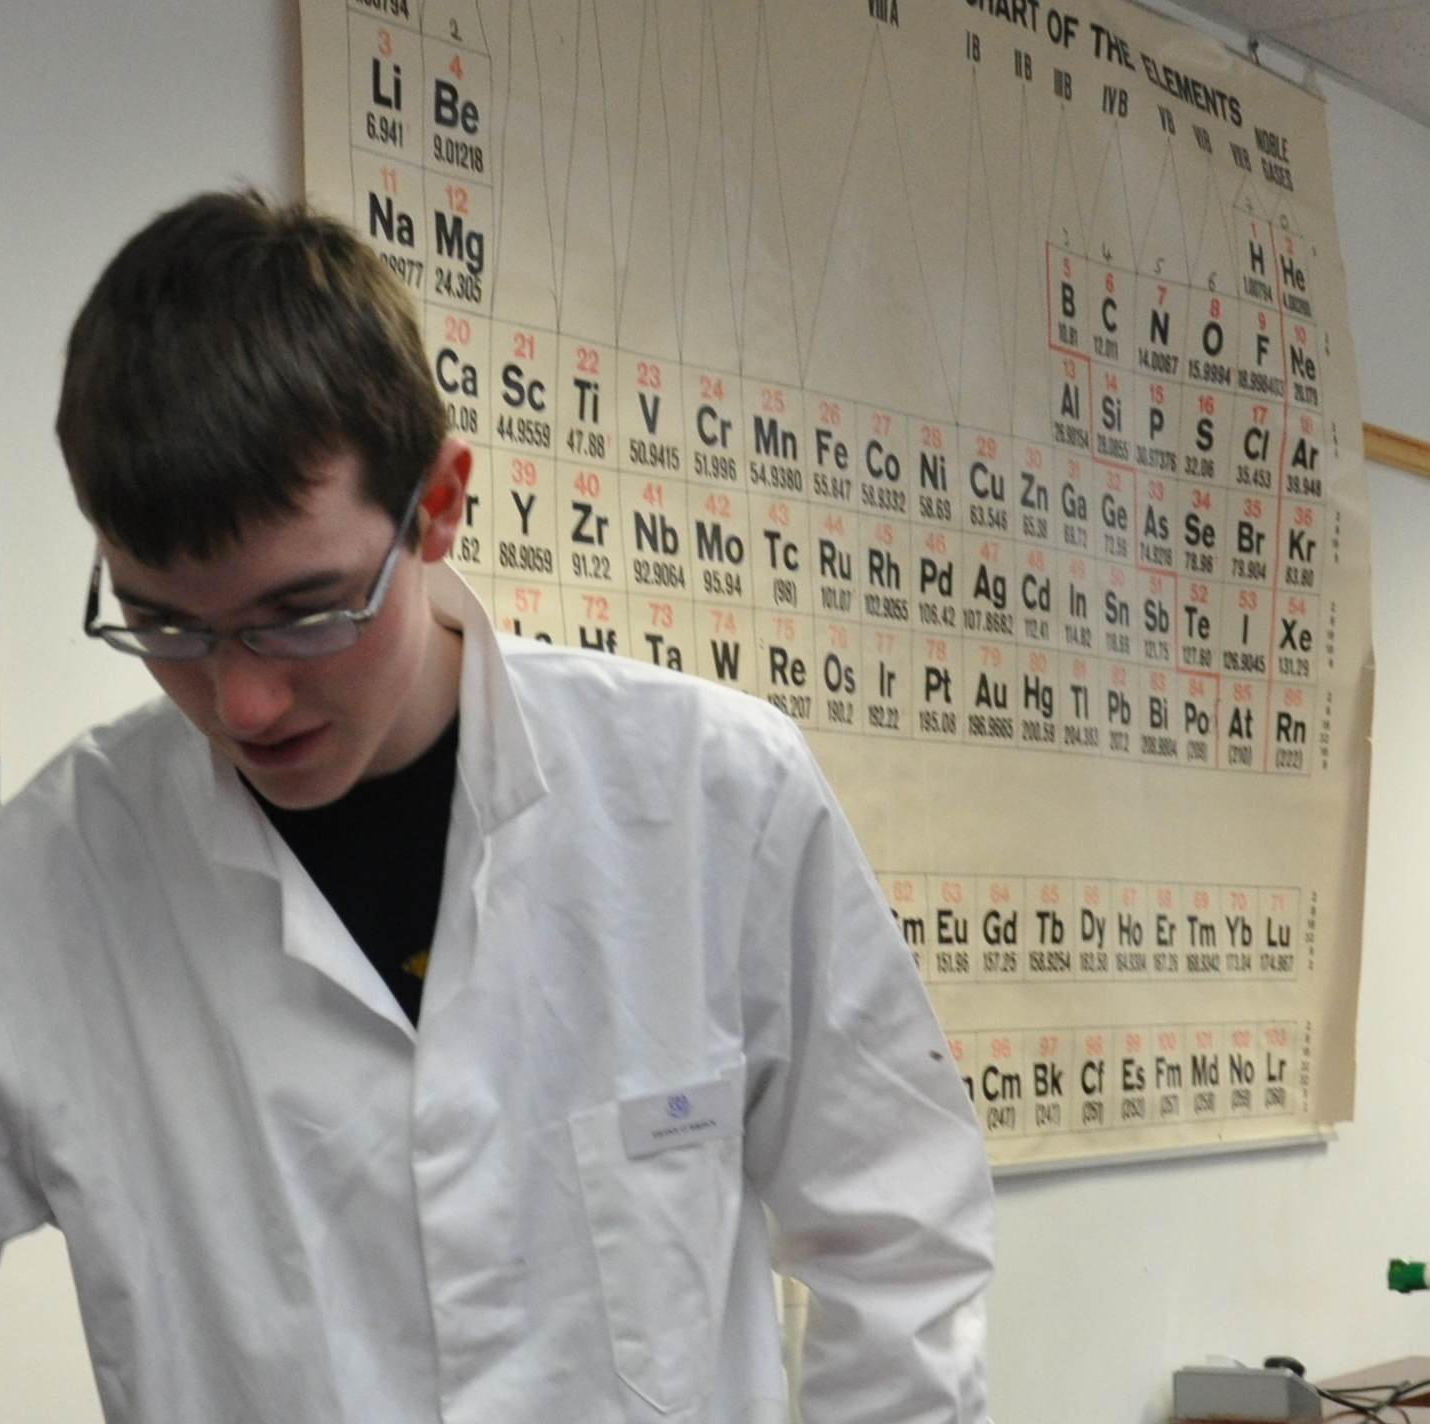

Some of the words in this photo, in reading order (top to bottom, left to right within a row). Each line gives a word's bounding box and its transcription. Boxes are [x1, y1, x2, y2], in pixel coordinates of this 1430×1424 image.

[379, 29, 392, 55] 3
[448, 54, 464, 80] 4
[1047, 9, 1079, 49] OF
[1090, 23, 1136, 71] THE
[1140, 52, 1242, 127] ELEMENTS
[371, 58, 403, 111] Li
[433, 80, 480, 135] Be
[366, 113, 404, 147] 6.941
[433, 134, 484, 174] 9.01218
[1255, 125, 1289, 164] NOBLE
[380, 167, 398, 195] 11
[445, 185, 468, 214] 12
[368, 191, 414, 248] Na
[434, 211, 485, 276] Mg
[434, 267, 482, 304] 24.305
[1105, 272, 1114, 294] 6
[1157, 285, 1167, 306] 7
[1209, 298, 1220, 318] 8
[1248, 240, 1265, 276] H
[1280, 254, 1306, 293] He
[444, 316, 471, 345] 20
[513, 332, 535, 360] 21
[576, 347, 599, 375] 22
[637, 362, 661, 389] 23
[700, 376, 724, 400] 24
[1061, 282, 1076, 318] B
[1102, 297, 1117, 332] C
[1150, 309, 1170, 346] N
[1202, 322, 1223, 356] O
[1256, 334, 1270, 366] F
[1290, 345, 1316, 381] Ne
[436, 348, 478, 398] Ca
[501, 364, 546, 411] Sc
[573, 379, 599, 424] Ti
[638, 392, 660, 434] V
[696, 405, 732, 449] Cr
[753, 415, 798, 461] Mn
[815, 429, 848, 470] Fe
[865, 440, 900, 481] Co
[920, 452, 947, 492] Ni
[970, 462, 1005, 502] Cu
[1021, 473, 1049, 513] Zn
[1061, 483, 1088, 521] Ga
[1101, 493, 1128, 531] Ge
[1144, 505, 1169, 540] As
[1184, 513, 1216, 548] Se
[1237, 520, 1265, 555] Br
[1288, 528, 1316, 563] Kr
[497, 414, 551, 449] 44.9559
[566, 428, 606, 460] 47.88
[629, 439, 680, 472] 50.9415
[694, 452, 737, 481] 51.996
[1061, 383, 1080, 420] Al
[1101, 395, 1121, 431] Si
[1149, 408, 1164, 440] P
[1195, 418, 1214, 451] S
[1243, 427, 1269, 461] Cl
[1291, 438, 1319, 470] Ar
[511, 458, 537, 486] 39
[574, 471, 600, 498] 40
[643, 482, 663, 508] 41
[499, 541, 553, 574] 88.9059
[571, 552, 611, 581] 91.22
[633, 560, 686, 590] 92.9064
[703, 571, 742, 598] 95.94
[511, 490, 536, 535] Y
[571, 502, 609, 545] Zr
[633, 511, 679, 556] Nb
[696, 520, 744, 564] Mo
[763, 530, 800, 571] Tc
[819, 538, 852, 580] Ru
[868, 548, 901, 590] Rh
[920, 557, 953, 597] Pd
[973, 564, 1007, 610] Ag
[1021, 574, 1051, 612] Cd
[1070, 583, 1087, 619] In
[1105, 590, 1130, 627] Sn
[1144, 600, 1169, 633] Sb
[1184, 605, 1210, 640] Te
[1242, 614, 1249, 645] I
[1279, 617, 1313, 652] Xe
[645, 632, 683, 673] Ta
[710, 640, 741, 681] W
[769, 646, 807, 687] Re
[824, 653, 856, 694] Os
[879, 662, 896, 698] Ir
[925, 666, 952, 704] Pt
[975, 673, 1007, 709] Au
[1023, 675, 1054, 719] Hg
[1108, 690, 1131, 726] Pb
[1149, 696, 1168, 730] Bi
[1184, 702, 1210, 736] Po
[1228, 707, 1253, 740] At
[1276, 711, 1307, 744] Rn
[936, 909, 969, 946] Eu
[982, 911, 1018, 947] Gd
[1036, 911, 1065, 945] Tb
[1080, 908, 1106, 950] Dy
[1118, 914, 1143, 947] Ho
[1156, 914, 1176, 946] Er
[1186, 915, 1217, 948] Tm
[1225, 915, 1253, 947] Yb
[1266, 917, 1291, 948] Lu
[982, 1065, 1022, 1102] Cm
[1033, 1062, 1063, 1097] Bk
[1080, 1060, 1105, 1096] Cf
[1121, 1058, 1146, 1092] Es
[1155, 1056, 1182, 1089] Fm
[1191, 1053, 1220, 1087] Md
[1229, 1052, 1255, 1085] No
[1266, 1051, 1287, 1082] Lr
